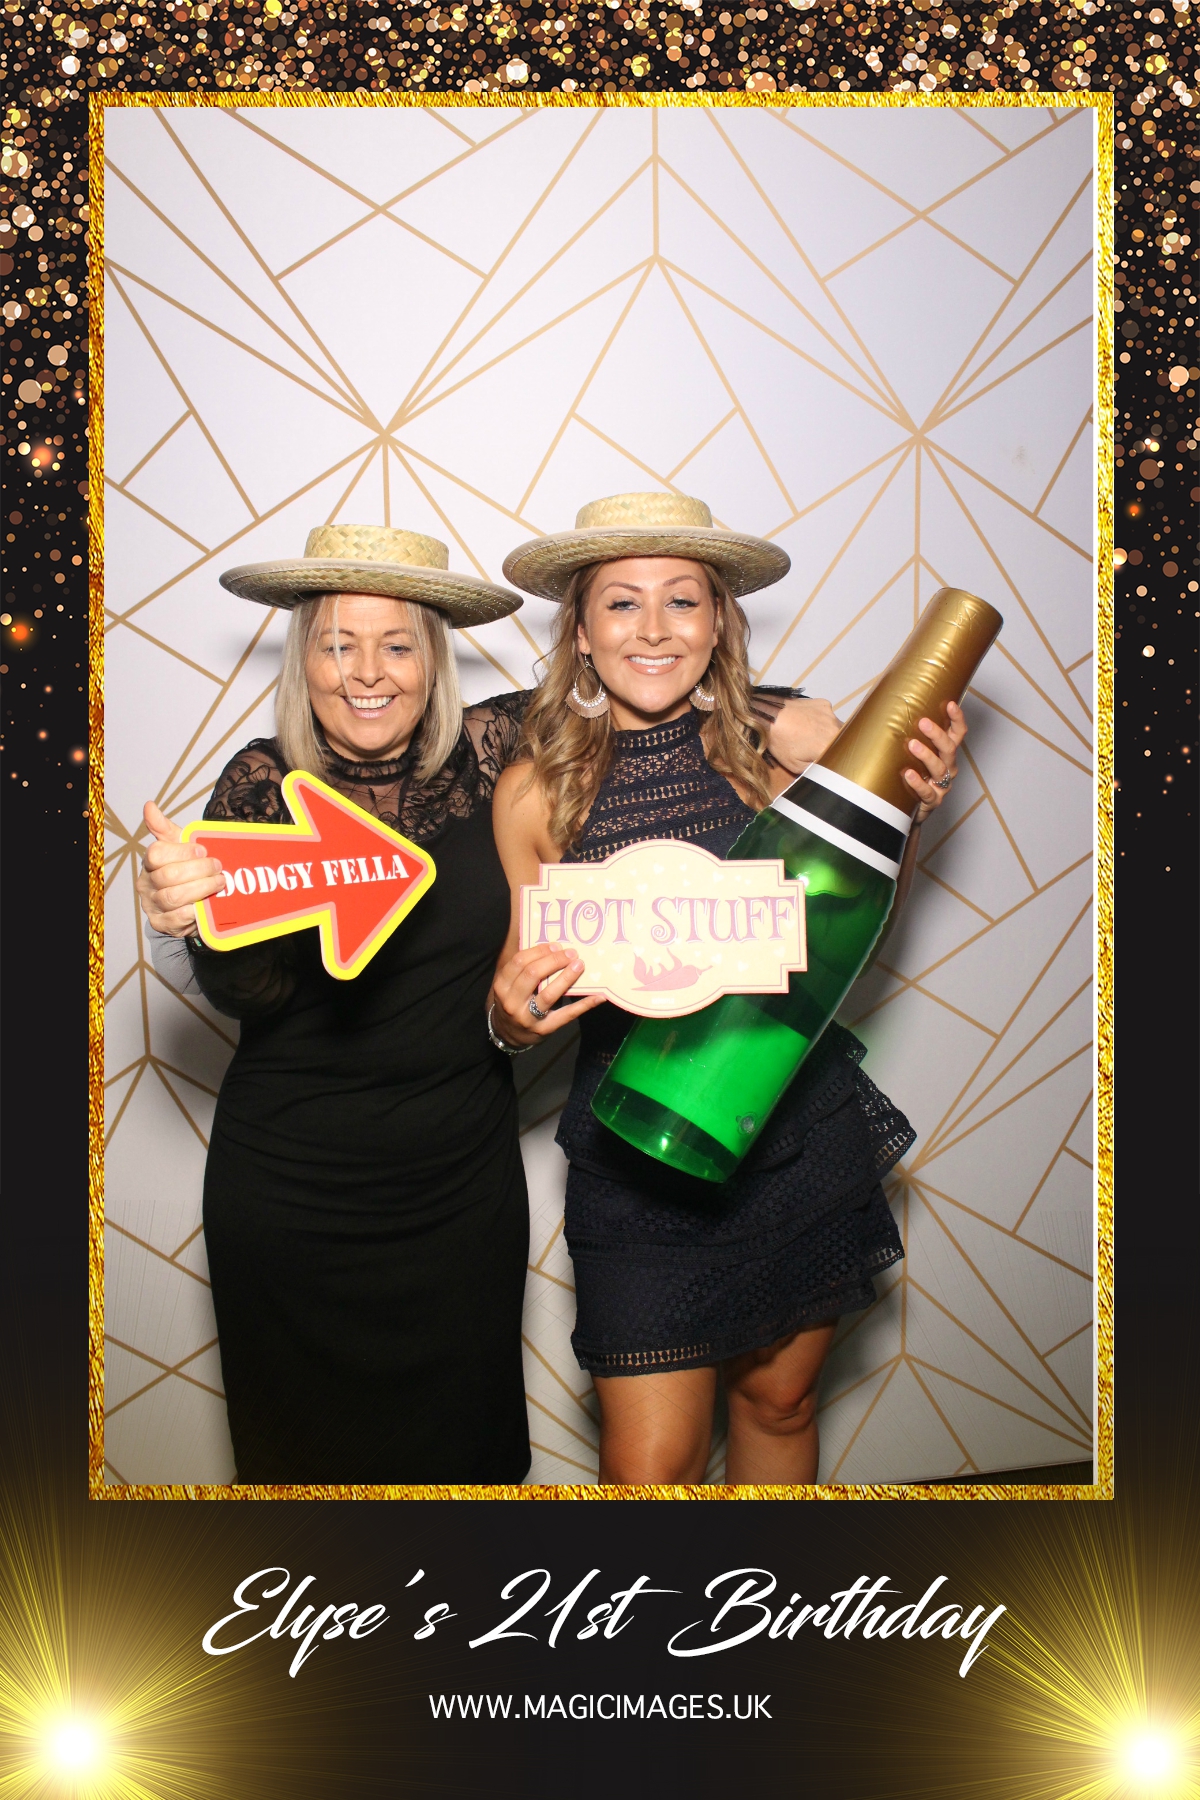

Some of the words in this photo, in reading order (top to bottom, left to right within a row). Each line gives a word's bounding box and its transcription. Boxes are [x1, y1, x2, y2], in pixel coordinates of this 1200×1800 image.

[321, 854, 410, 887] FELLA
[535, 898, 635, 946] HOT
[650, 895, 797, 945] STUFF
